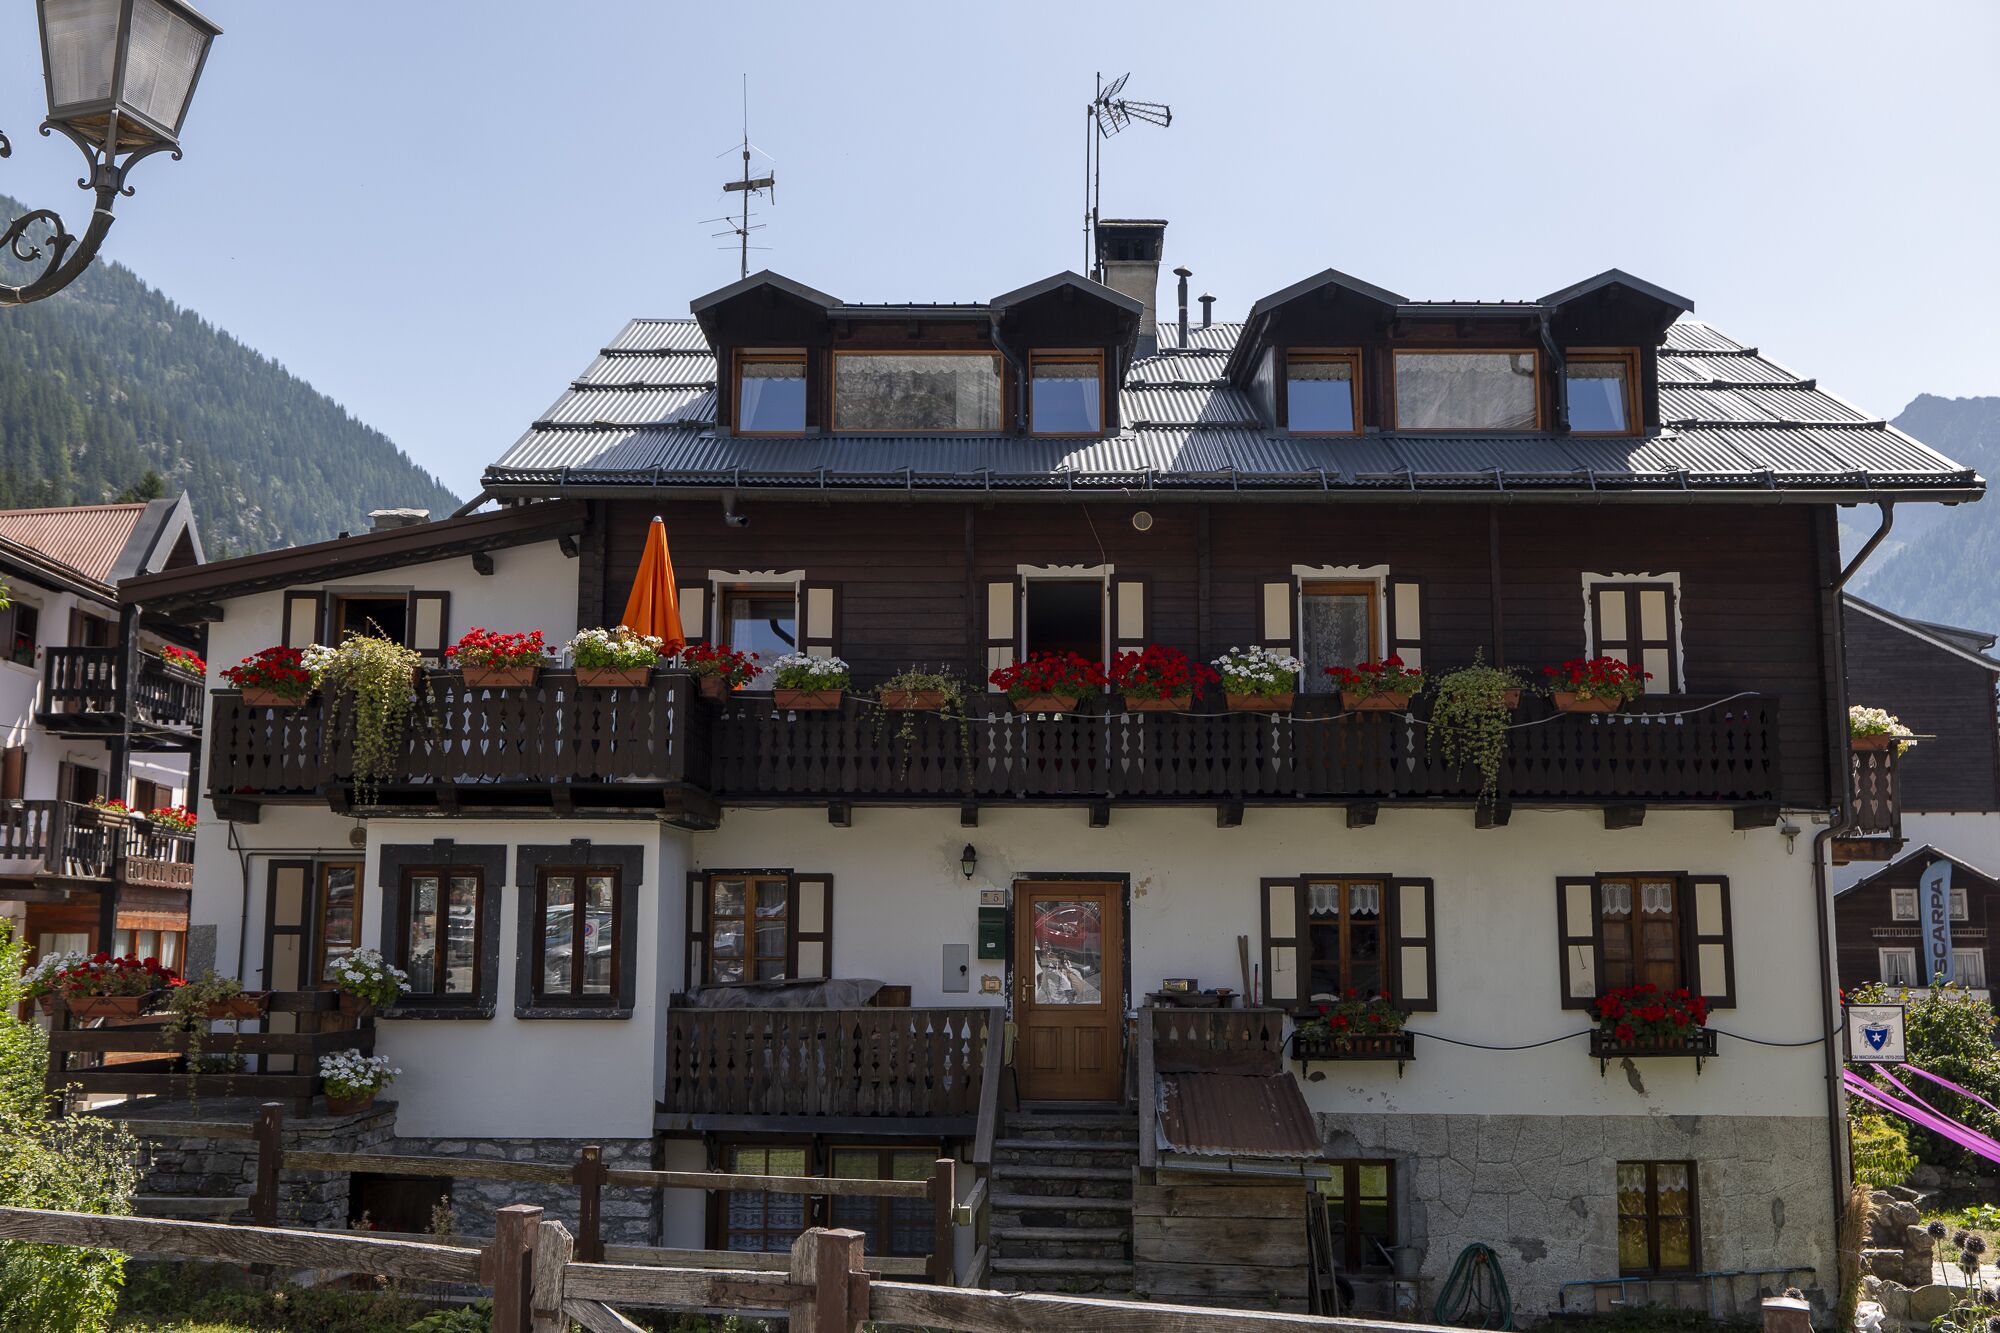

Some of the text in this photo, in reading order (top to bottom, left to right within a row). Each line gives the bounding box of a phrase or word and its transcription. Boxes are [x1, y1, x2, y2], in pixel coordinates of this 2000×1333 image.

[128, 860, 166, 881] HOTEL
[993, 893, 999, 902] 5
[1930, 877, 1948, 975] SCARPA
